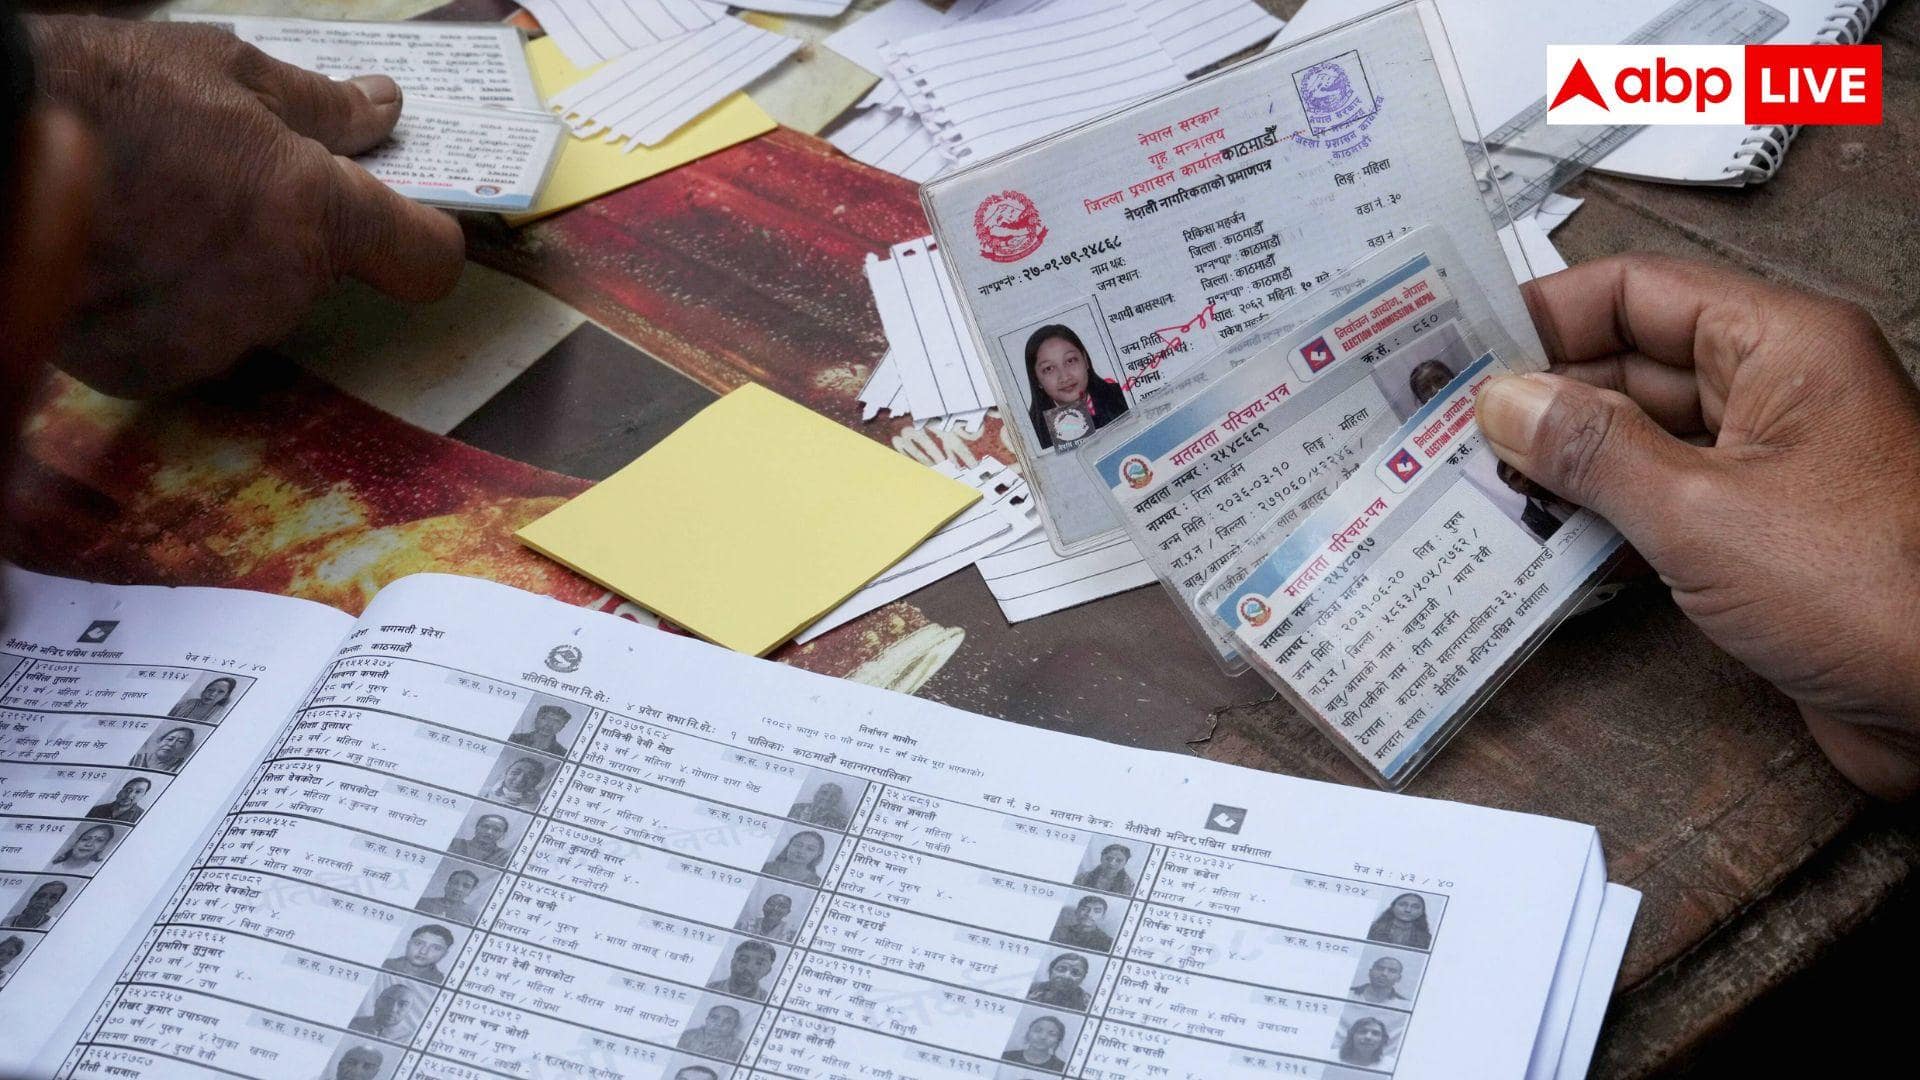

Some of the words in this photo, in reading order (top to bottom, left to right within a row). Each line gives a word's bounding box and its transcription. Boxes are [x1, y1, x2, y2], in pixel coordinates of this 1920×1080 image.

[1137, 125, 1173, 146] नेपाल
[1177, 106, 1220, 132] सरकार
[1148, 150, 1168, 170] गृह
[1361, 158, 1391, 176] महिला
[1083, 190, 1124, 215] जिल्ला
[1128, 170, 1176, 197] प्रशासन
[1124, 198, 1159, 221] नेपाली
[1157, 173, 1227, 208] नागरिकताको
[1226, 159, 1272, 185] प्रमाणपत्र
[1182, 223, 1216, 243] रिकिसा
[1215, 210, 1246, 229] महर्जन
[1188, 240, 1217, 259] जिल्ला
[1095, 277, 1118, 291] जन्म
[1199, 272, 1229, 292] जिल्ला
[1238, 297, 1265, 314] २०६२
[1300, 281, 1312, 292] १०
[1107, 306, 1135, 324] स्थायी
[1333, 314, 1370, 341] निर्वाचन
[1402, 279, 1429, 299] नेपाल
[1341, 328, 1373, 352] ELECTION
[1413, 291, 1436, 309] NEPAL
[1412, 314, 1439, 333] ८६०
[1119, 341, 1141, 355] जन्म
[1169, 429, 1220, 466] मतदाता
[1221, 382, 1291, 432] परिचय-पत्र
[1412, 418, 1445, 449] निर्वाचन
[1424, 431, 1452, 458] ELECTION
[1133, 485, 1171, 514] मतदाता
[1171, 465, 1202, 488] नम्बर
[1210, 422, 1270, 463] २५४८६८९
[1158, 532, 1182, 551] जन्म
[1181, 515, 1207, 536] मिति
[1216, 461, 1290, 513] २०३६-०३-१०
[1337, 407, 1369, 431] महिला
[1189, 484, 1213, 503] रिना
[1214, 462, 1246, 486] महर्जन
[1214, 515, 1247, 540] जिल्ला
[1283, 554, 1329, 597] मतदाता
[1328, 496, 1388, 553] परिचय-पत्र
[1259, 617, 1294, 649] मतदाता
[1290, 593, 1316, 617] नम्बर
[1323, 537, 1376, 584] २५४८०९७
[1292, 660, 1315, 681] जन्म
[1310, 640, 1334, 663] मिति
[1340, 570, 1405, 632] २०३१-०६-२०
[1442, 510, 1465, 534] पुरुष
[1313, 600, 1342, 626] राकेश
[1340, 572, 1369, 600] महर्जन
[1344, 630, 1375, 659] जिल्ला
[1381, 537, 1471, 624] ५८६३/५०५/२७६२
[1376, 641, 1396, 659] नाम
[1452, 562, 1475, 583] माया
[1470, 545, 1492, 563] देवी
[419, 626, 446, 639] प्रदेश
[1387, 661, 1408, 681] नाम
[1411, 636, 1433, 656] रीना
[1430, 609, 1460, 637] महर्जन
[1373, 729, 1404, 759] मतदान
[1403, 707, 1427, 730] स्थल
[1433, 664, 1469, 697] मैतीदेवी
[1514, 582, 1550, 617] धर्मशाला
[637, 705, 662, 719] प्रदेश
[1354, 716, 1386, 745] ठेगाना
[1024, 802, 1041, 812] ३०
